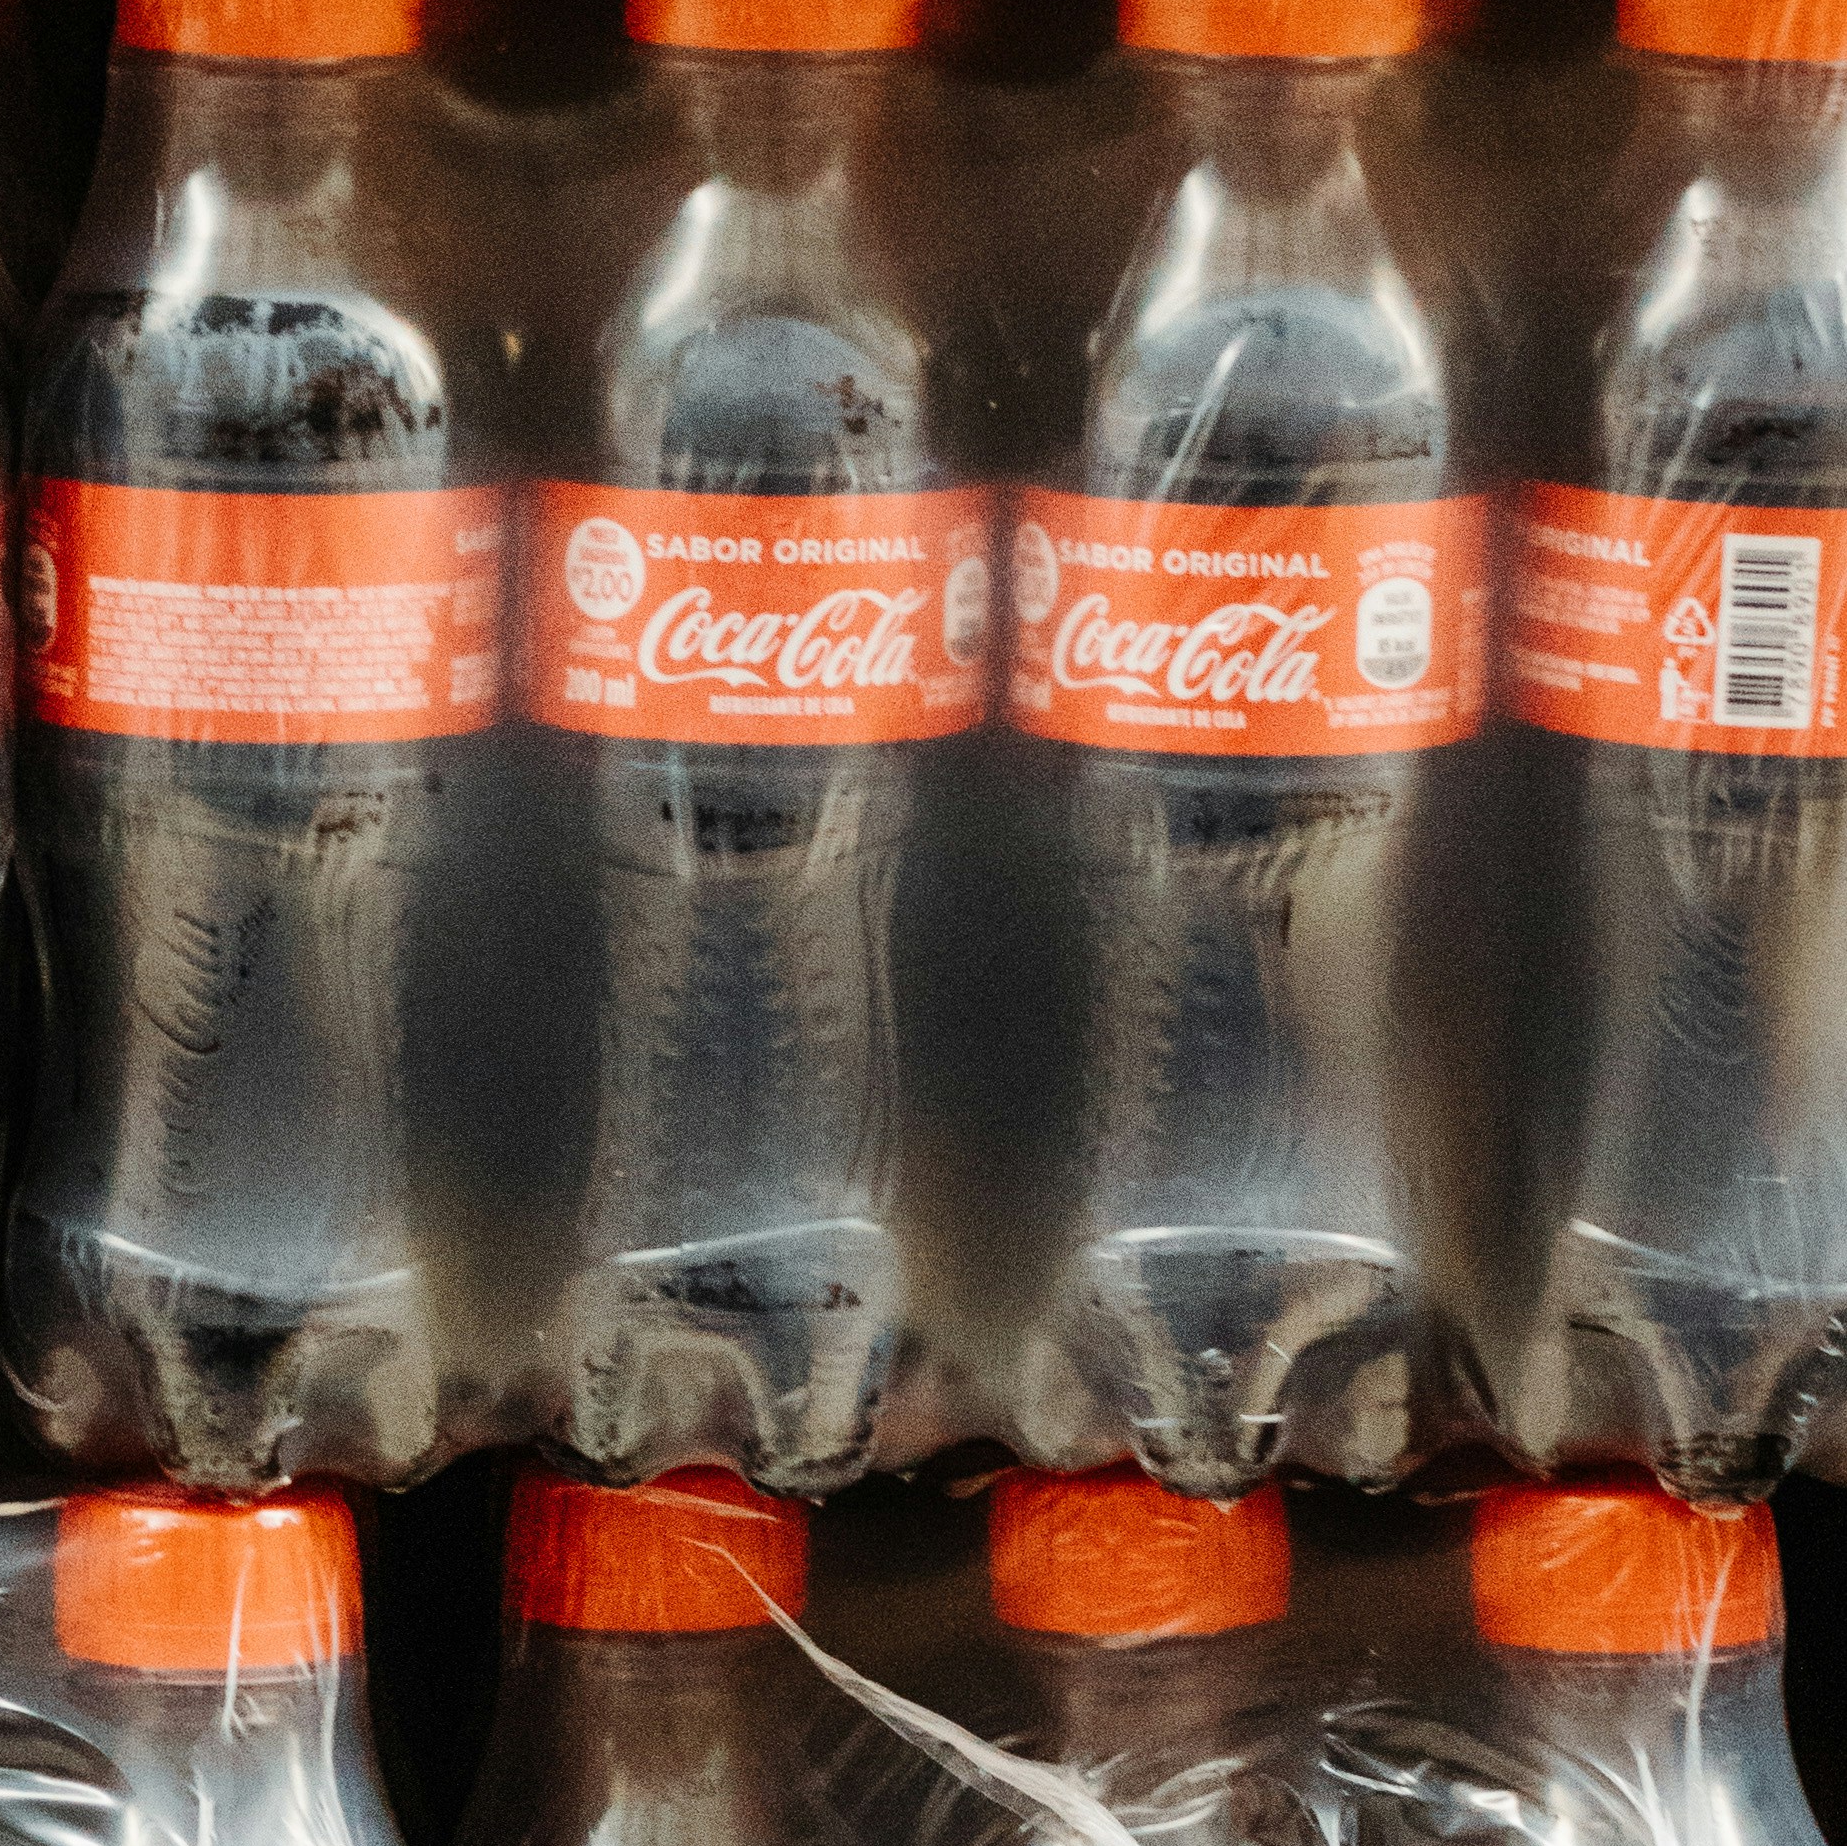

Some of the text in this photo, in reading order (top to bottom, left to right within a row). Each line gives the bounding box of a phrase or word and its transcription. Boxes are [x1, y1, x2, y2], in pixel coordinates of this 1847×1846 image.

[647, 534, 925, 565] SABOR ORIGINAL
[1059, 539, 1153, 574] SABOR
[1163, 550, 1329, 579] ORIGINAL
[638, 587, 931, 689] Coca-Cola
[1055, 594, 1337, 702] Coca-Cola
